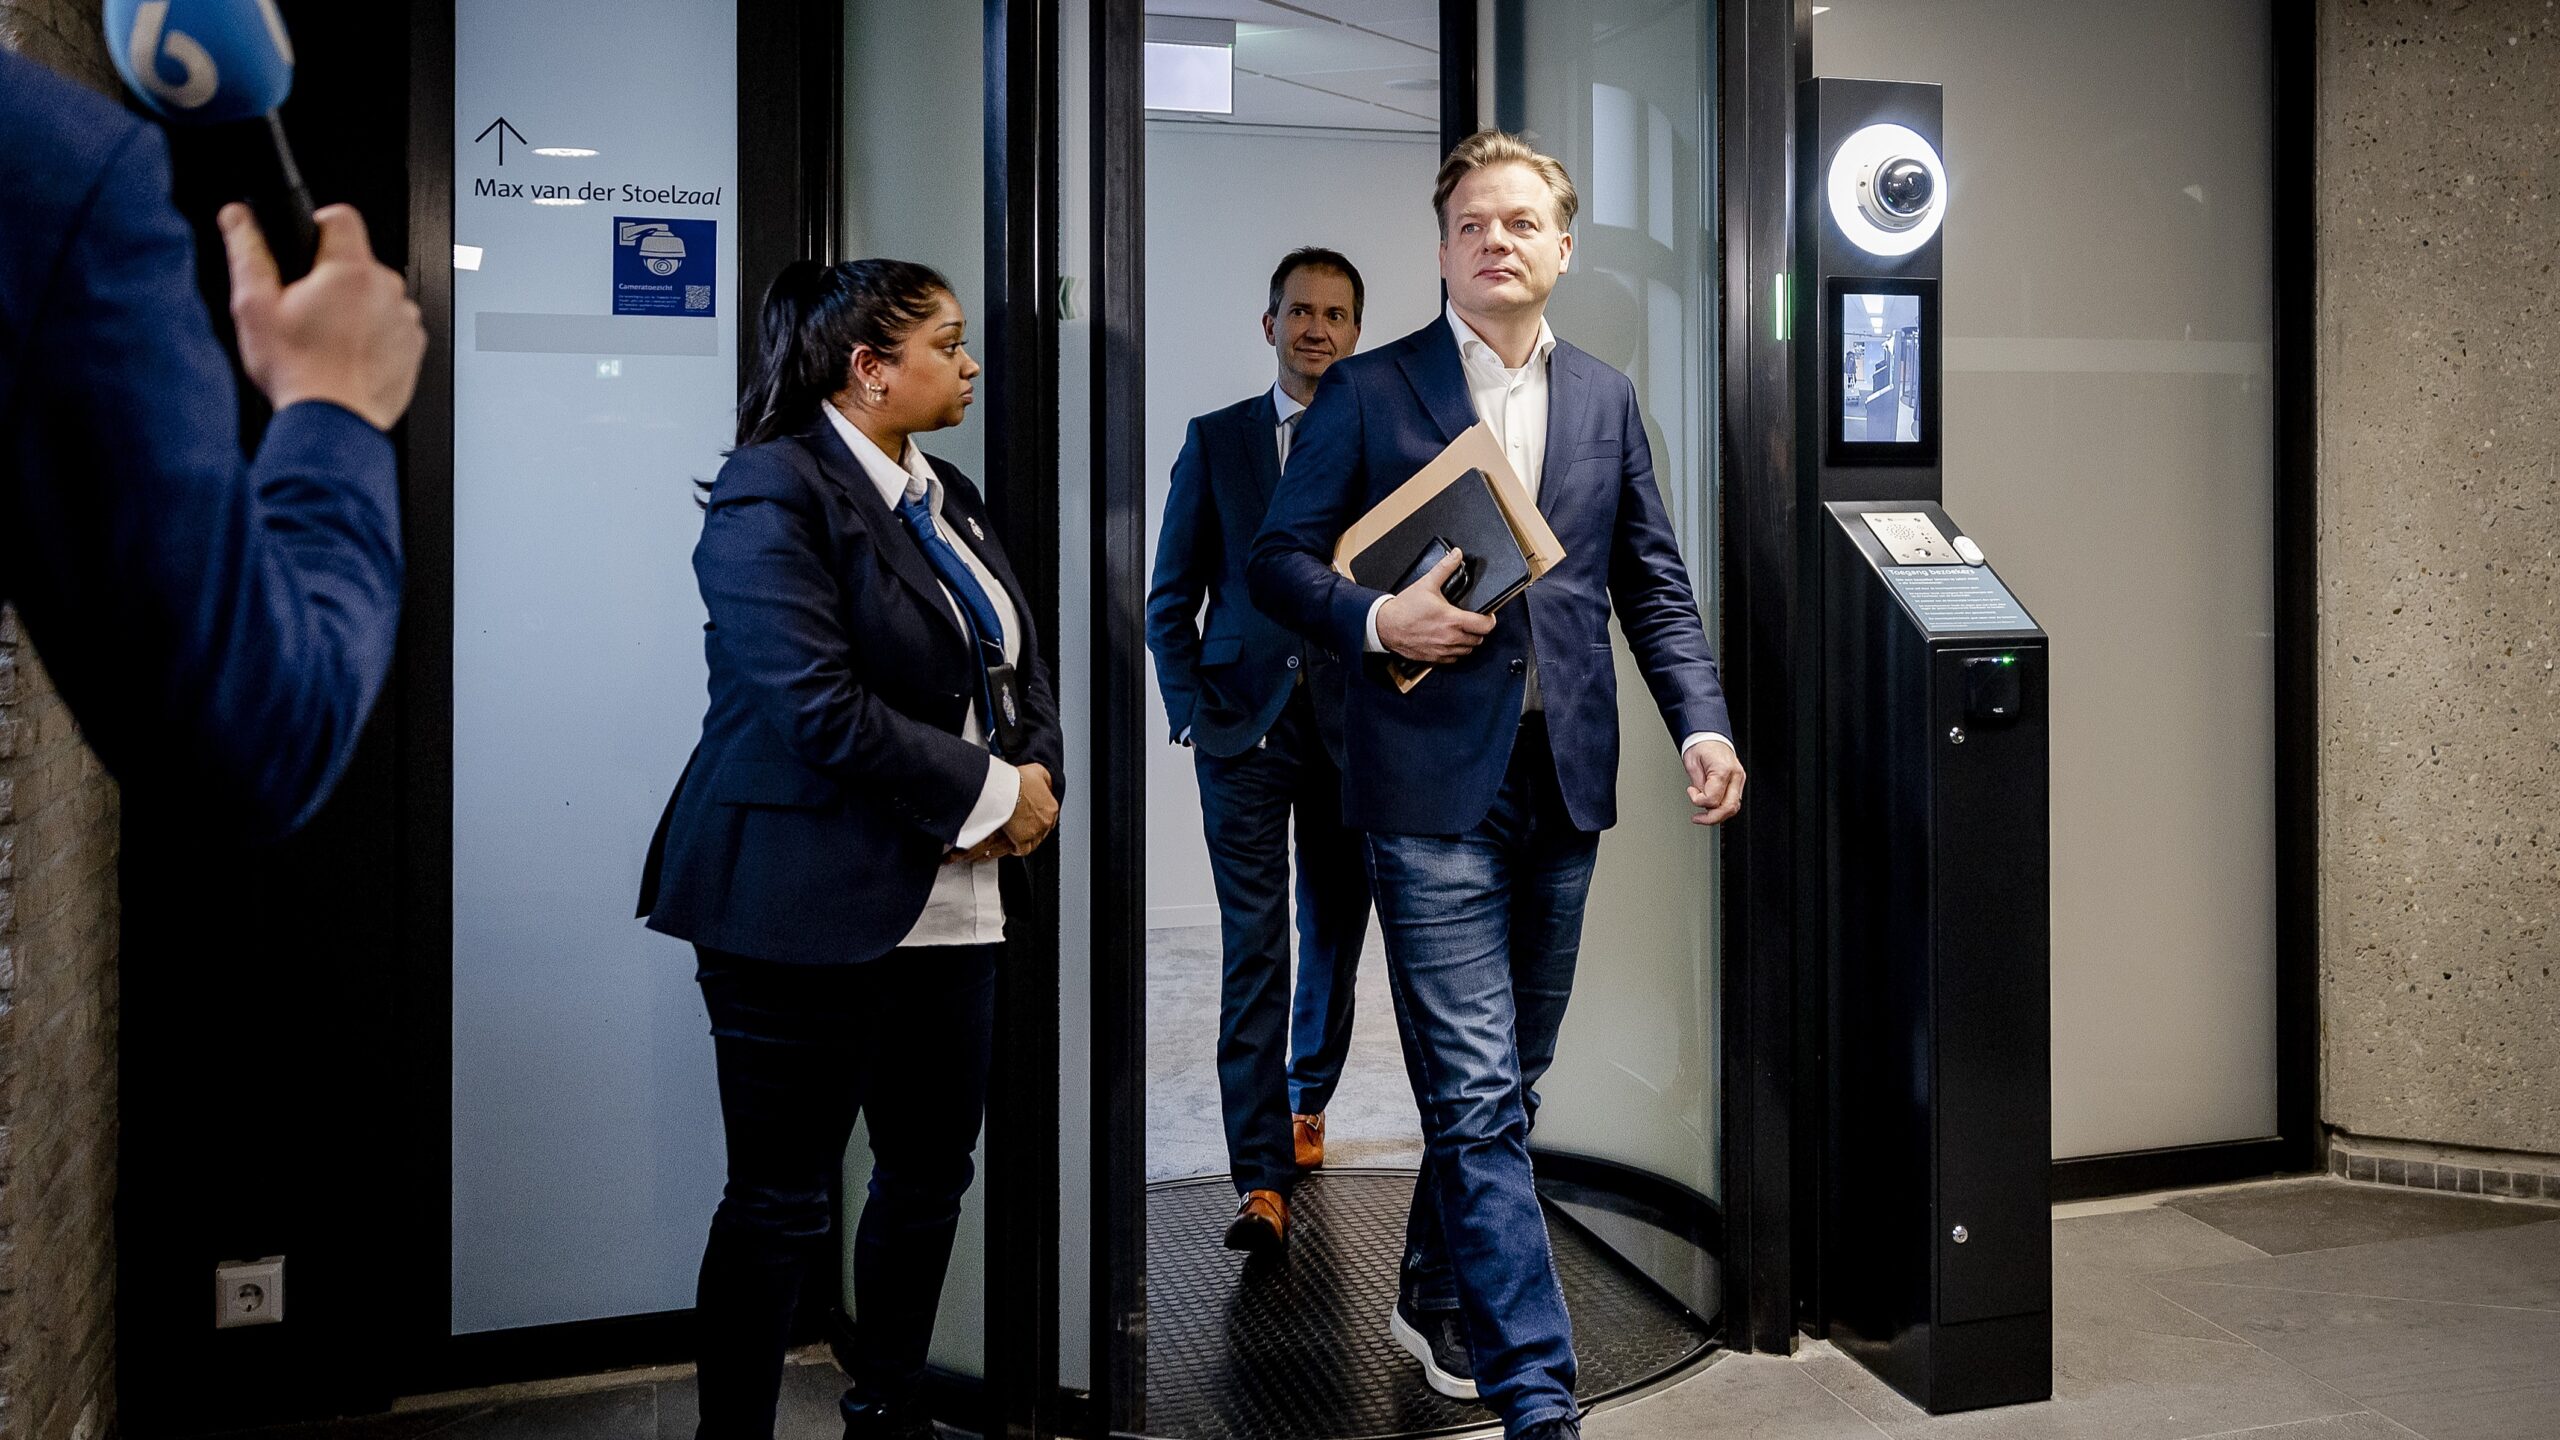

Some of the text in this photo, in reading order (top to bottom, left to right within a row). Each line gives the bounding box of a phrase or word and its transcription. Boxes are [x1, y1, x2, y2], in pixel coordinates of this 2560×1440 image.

[130, 0, 219, 109] 6
[474, 178, 722, 206] Max van der Stoelzaal
[618, 283, 673, 291] Cameratoezicht
[1888, 569, 1929, 577] Toegang
